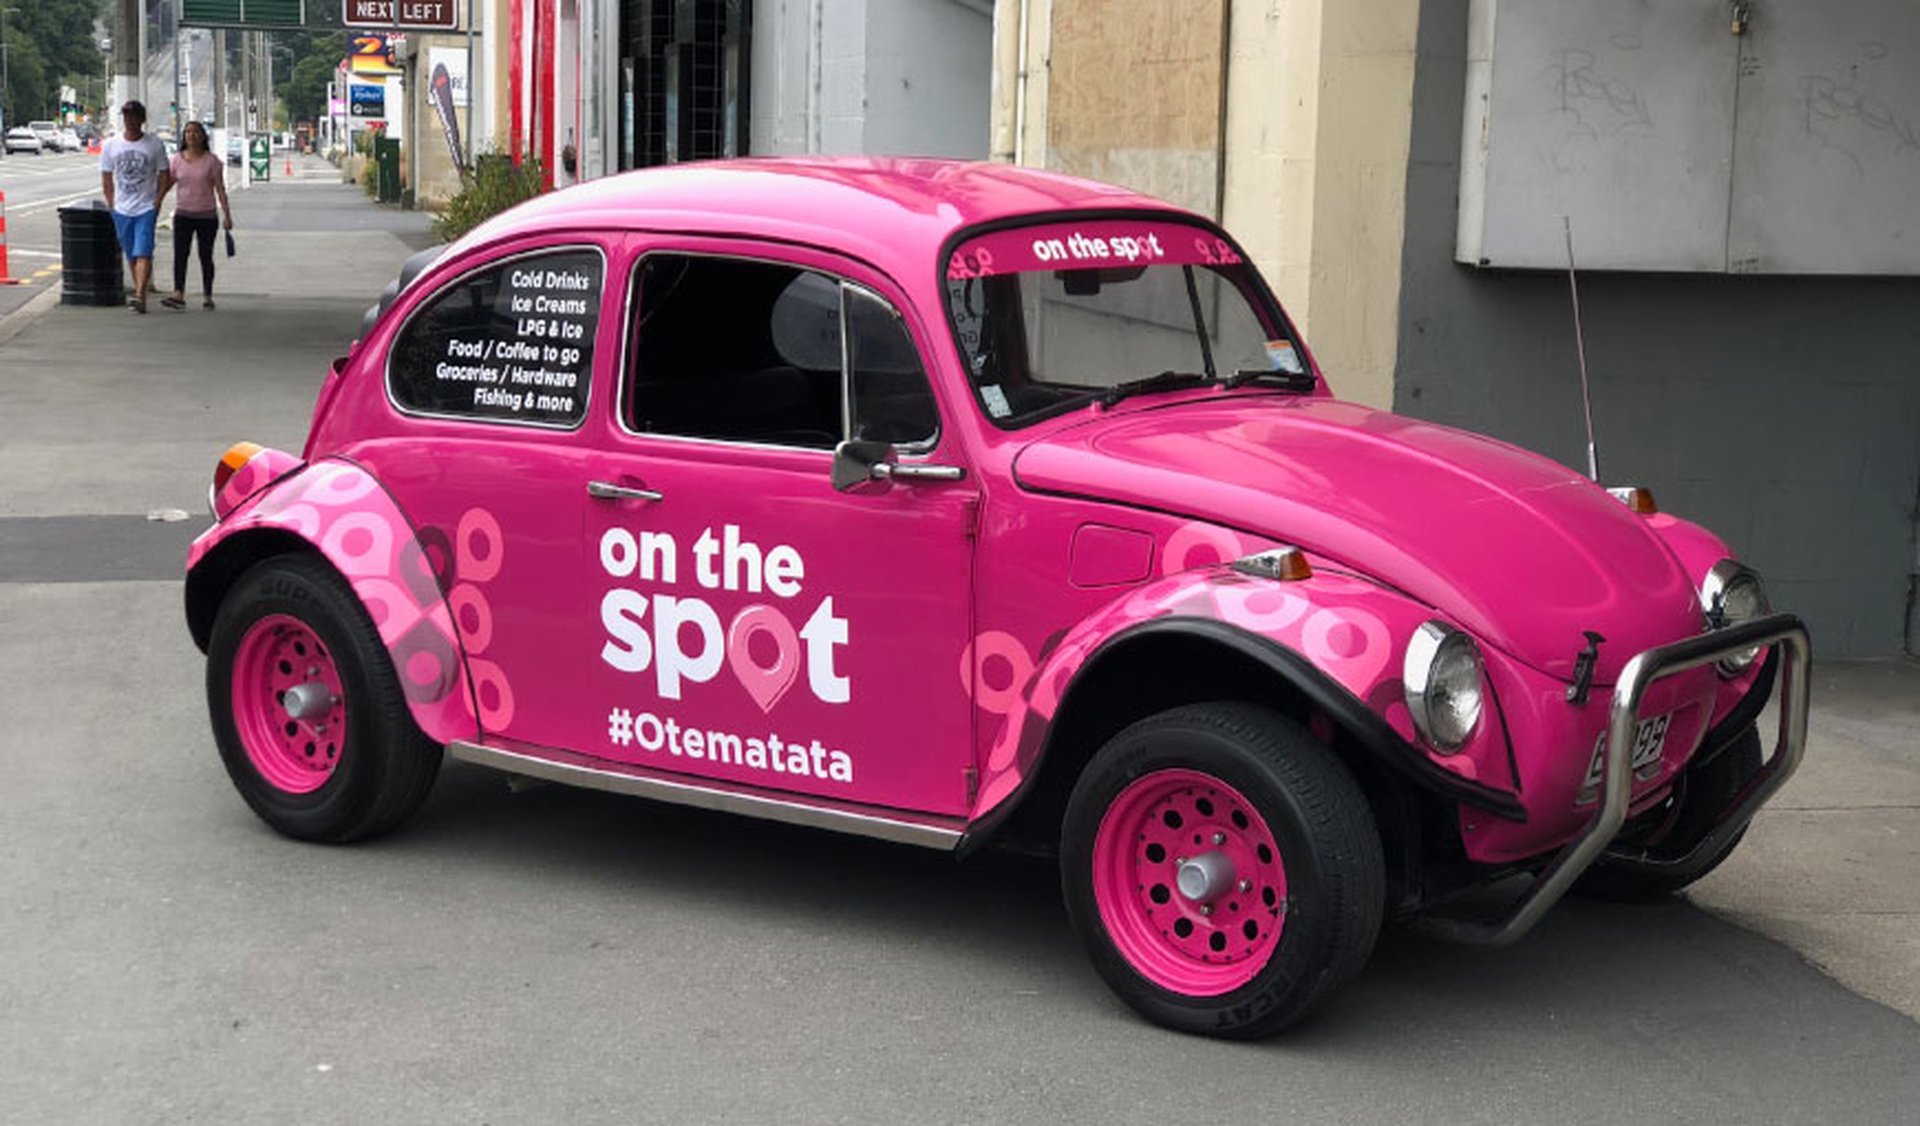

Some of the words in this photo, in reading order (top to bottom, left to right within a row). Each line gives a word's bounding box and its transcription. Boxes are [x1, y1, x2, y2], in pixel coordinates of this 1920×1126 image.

[356, 1, 395, 18] NEXT
[402, 3, 444, 20] LEFT
[1032, 239, 1069, 261] on
[1066, 231, 1111, 259] the
[1109, 231, 1164, 262] spot
[511, 270, 543, 289] Cold
[545, 272, 589, 290] Drinks
[511, 296, 533, 313] Ice
[535, 296, 586, 315] Creams
[517, 319, 546, 338] LPG
[548, 321, 560, 337] &
[561, 321, 583, 339] Ice
[447, 339, 484, 357] Food
[483, 339, 494, 360] /
[495, 342, 540, 360] Coffee
[543, 344, 558, 361] to
[560, 347, 580, 366] go
[436, 362, 498, 383] Groceries
[499, 364, 510, 384] /
[511, 366, 577, 388] Hardware
[474, 388, 523, 412] Fishing
[524, 391, 535, 409] &
[536, 397, 574, 412] more
[600, 527, 677, 584] on
[692, 524, 805, 598] the
[600, 588, 851, 714] spot
[607, 706, 854, 783] #Otematata
